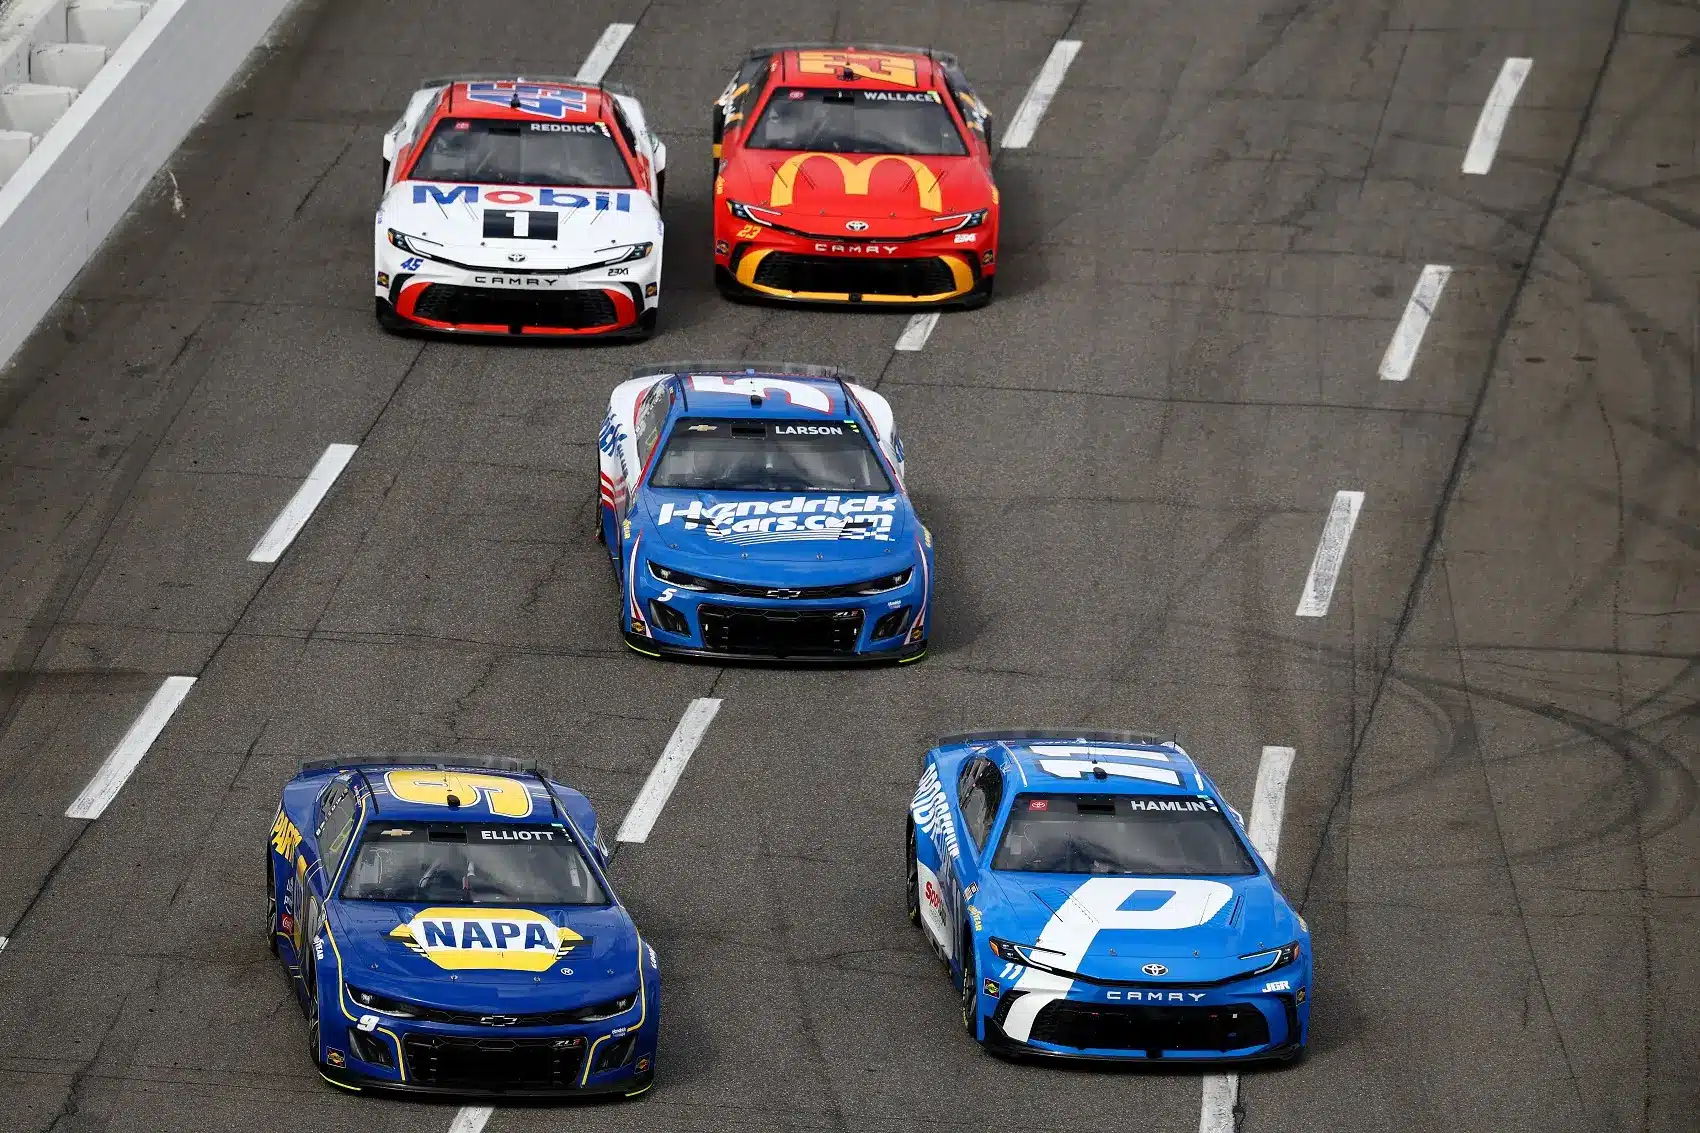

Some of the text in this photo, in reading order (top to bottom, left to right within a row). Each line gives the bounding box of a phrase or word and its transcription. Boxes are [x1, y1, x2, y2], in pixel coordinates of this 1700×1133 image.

[864, 91, 934, 102] WALLACE
[530, 123, 597, 133] REDDICK
[412, 185, 630, 213] Mobil
[505, 211, 530, 237] 1
[735, 225, 763, 239] 23
[815, 243, 898, 255] CAMRY
[400, 257, 425, 272] 45
[474, 276, 560, 286] CAMRY
[775, 425, 843, 436] LARSON
[657, 495, 898, 530] Hendrick
[657, 588, 677, 602] 5
[1130, 800, 1208, 812] HAMLIN
[481, 829, 554, 841] ELLIOTT
[422, 921, 556, 950] NAPA
[999, 962, 1024, 980] 11
[1262, 980, 1291, 993] JGR
[1106, 991, 1206, 1002] CAMRY
[357, 1014, 380, 1032] 9
